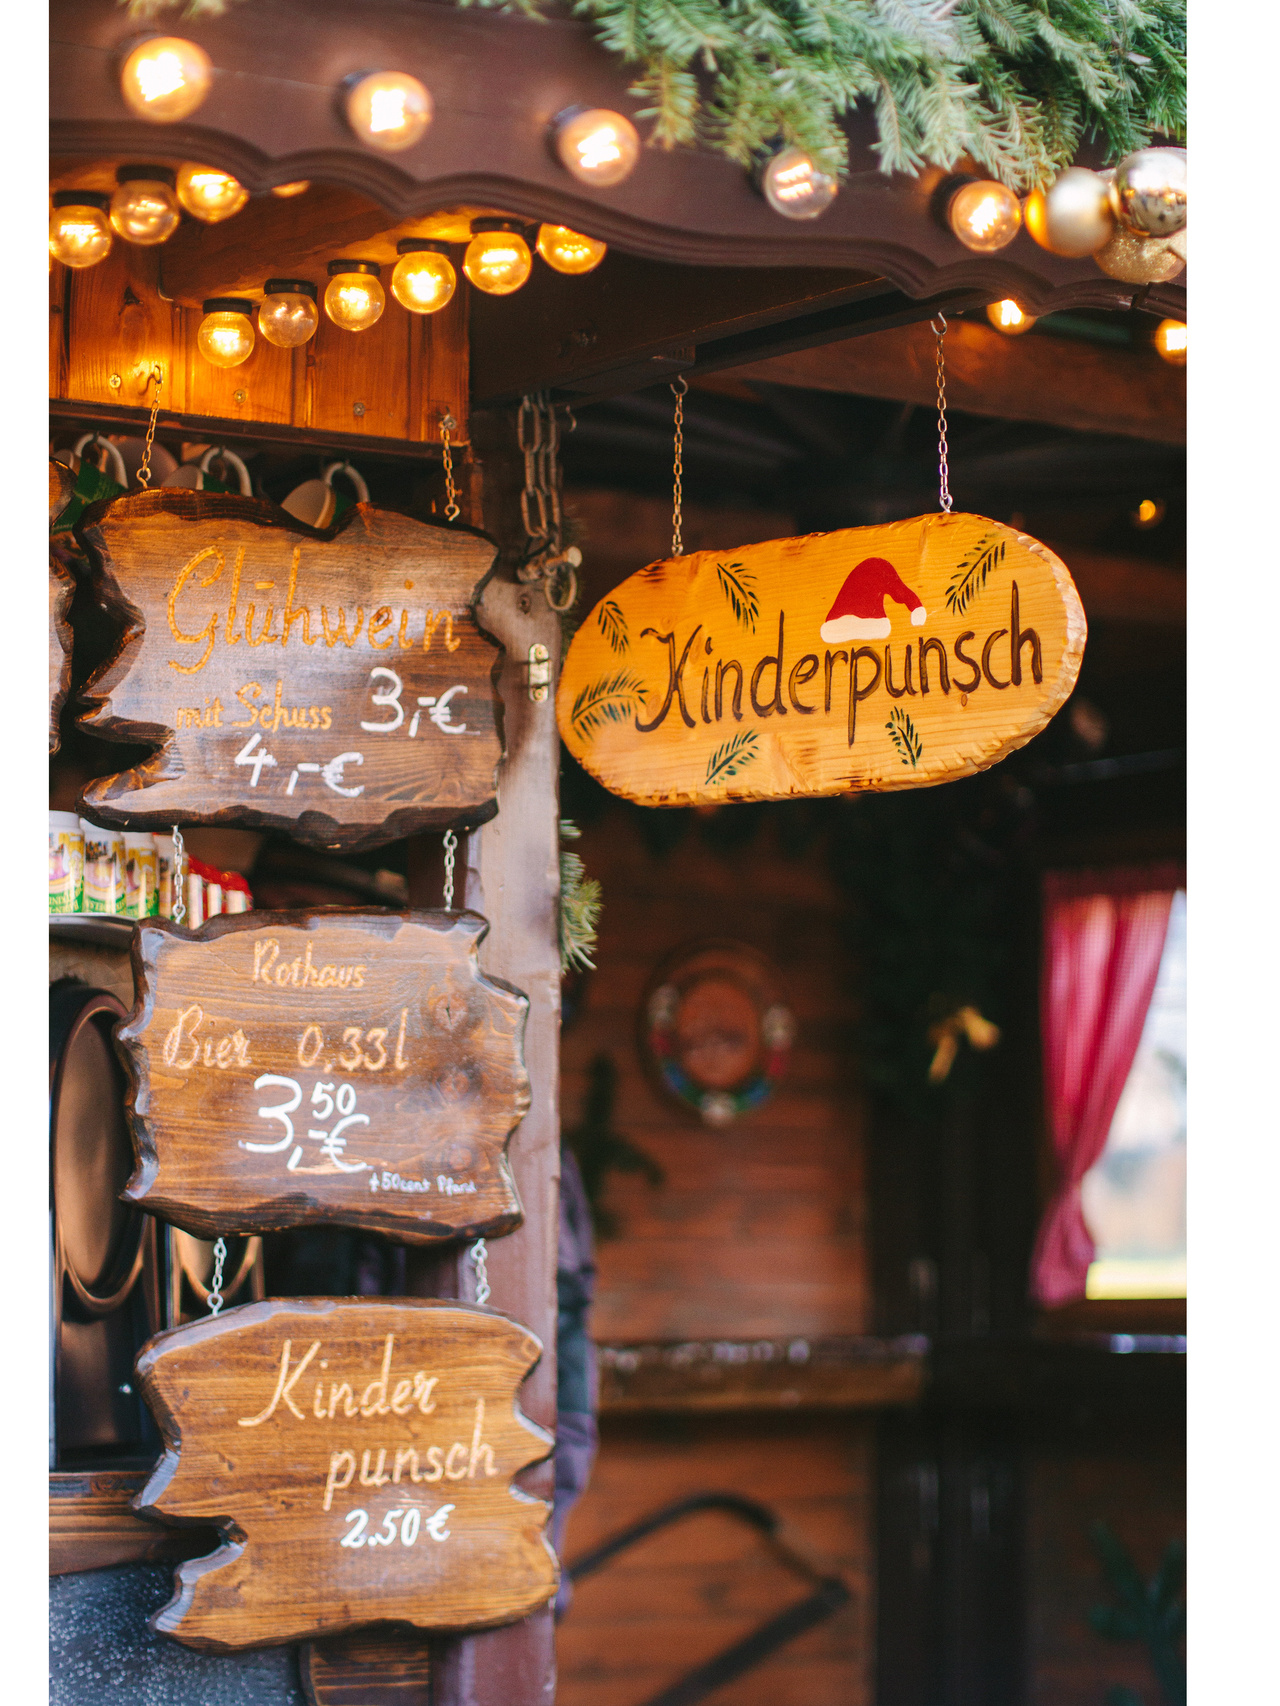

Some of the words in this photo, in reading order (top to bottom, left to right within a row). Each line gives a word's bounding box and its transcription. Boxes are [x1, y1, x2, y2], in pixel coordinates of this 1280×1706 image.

[167, 545, 462, 675] Glühwein
[176, 696, 224, 731] mit
[231, 679, 332, 734] Schuss
[634, 580, 1043, 748] Kinderpunsch
[251, 938, 369, 989] Rothaus
[162, 1003, 252, 1071] Bier
[238, 1333, 440, 1428] Kinder
[322, 1397, 500, 1512] punsch
